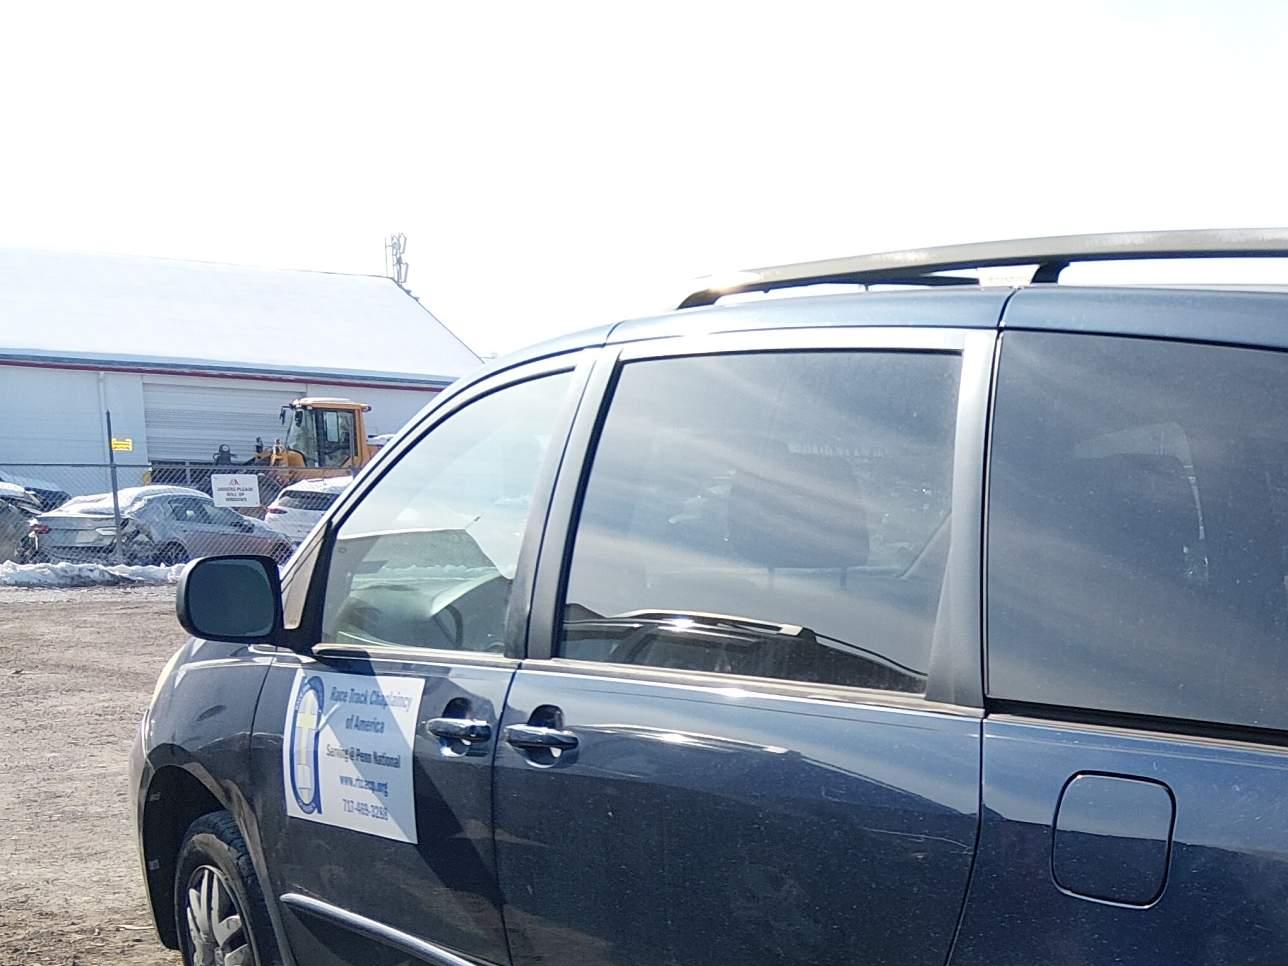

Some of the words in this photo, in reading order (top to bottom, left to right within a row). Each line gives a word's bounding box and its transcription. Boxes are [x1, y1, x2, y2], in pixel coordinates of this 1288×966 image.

[330, 686, 348, 702] Race
[348, 688, 368, 704] Track
[369, 690, 412, 713] Chaplaincy
[345, 714, 354, 730] of
[354, 715, 385, 734] America
[326, 744, 349, 762] Serving
[356, 748, 372, 764] Penn
[373, 751, 401, 769] National
